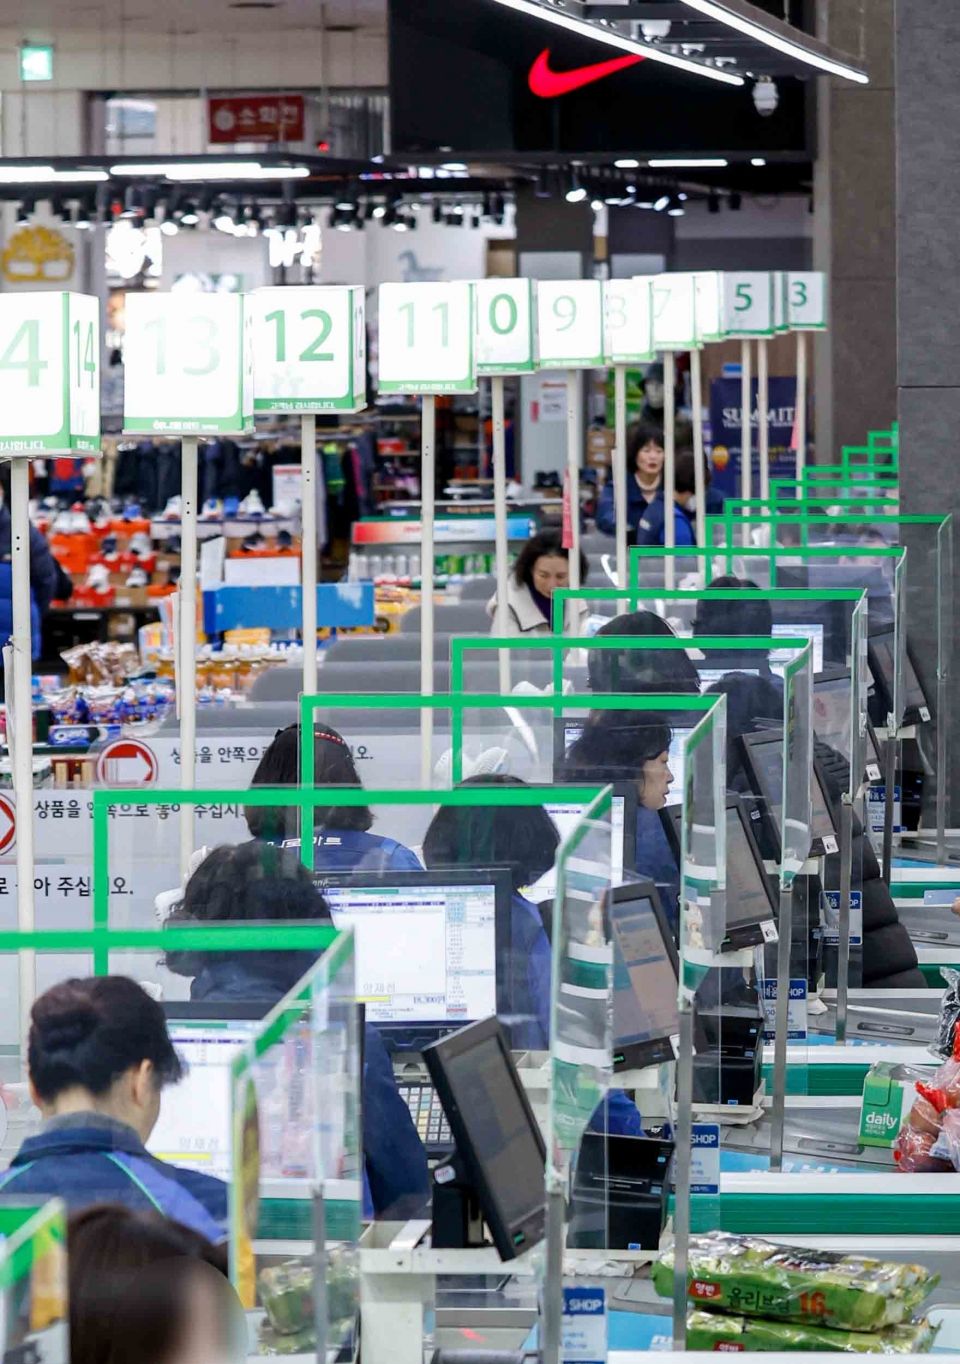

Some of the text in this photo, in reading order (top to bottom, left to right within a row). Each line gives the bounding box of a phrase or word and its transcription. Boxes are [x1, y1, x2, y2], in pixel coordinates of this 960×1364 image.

[733, 283, 753, 312] 5
[791, 281, 808, 307] 3
[397, 301, 450, 348] 11
[552, 294, 578, 332] 9
[144, 315, 221, 376] 13
[264, 308, 335, 362] 12
[73, 319, 96, 390] 14
[170, 745, 212, 763] 상을
[34, 799, 81, 819] 상품을
[193, 803, 246, 819] 주십시
[57, 877, 134, 897] 주십오.
[865, 1111, 898, 1130] daily
[690, 1134, 717, 1144] SHOP
[695, 1282, 716, 1297] 양반
[568, 1298, 602, 1312] SHOP
